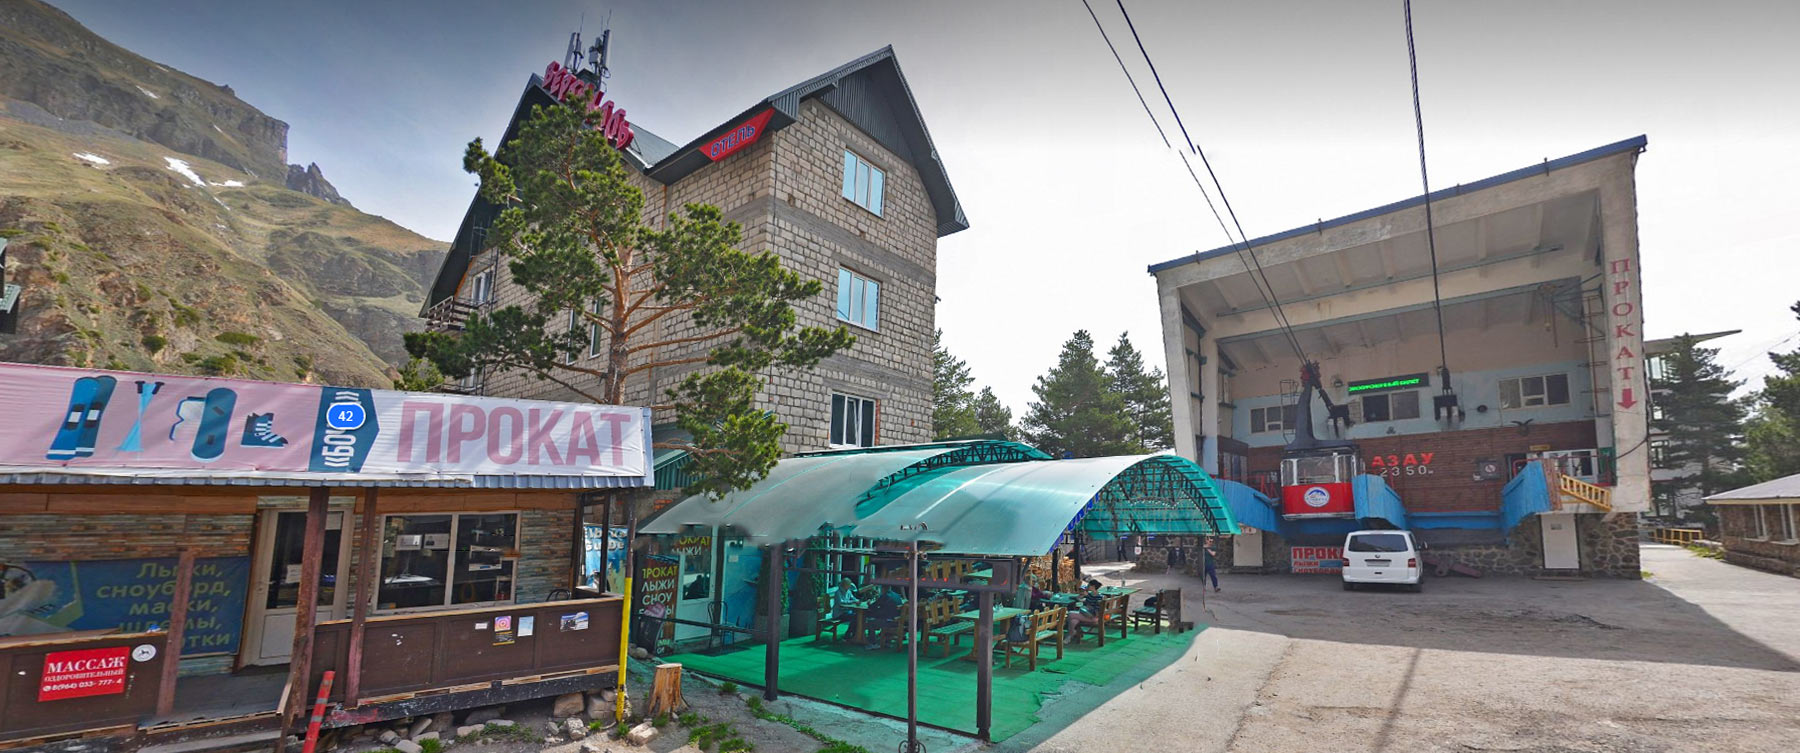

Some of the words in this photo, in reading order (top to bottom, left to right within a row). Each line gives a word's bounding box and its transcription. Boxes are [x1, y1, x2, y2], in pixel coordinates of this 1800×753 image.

[711, 125, 756, 158] ОТЕЛЬ
[1610, 258, 1635, 381] ПРОКАТ
[397, 401, 631, 467] ПРОКАТ
[1371, 452, 1434, 467] АЗАУ
[136, 562, 223, 579] Лыи,
[96, 581, 231, 600] сноубрд,
[641, 578, 675, 593] ЛЫЖИ
[642, 592, 673, 606] СНОУ
[47, 656, 125, 674] МАССАЖ
